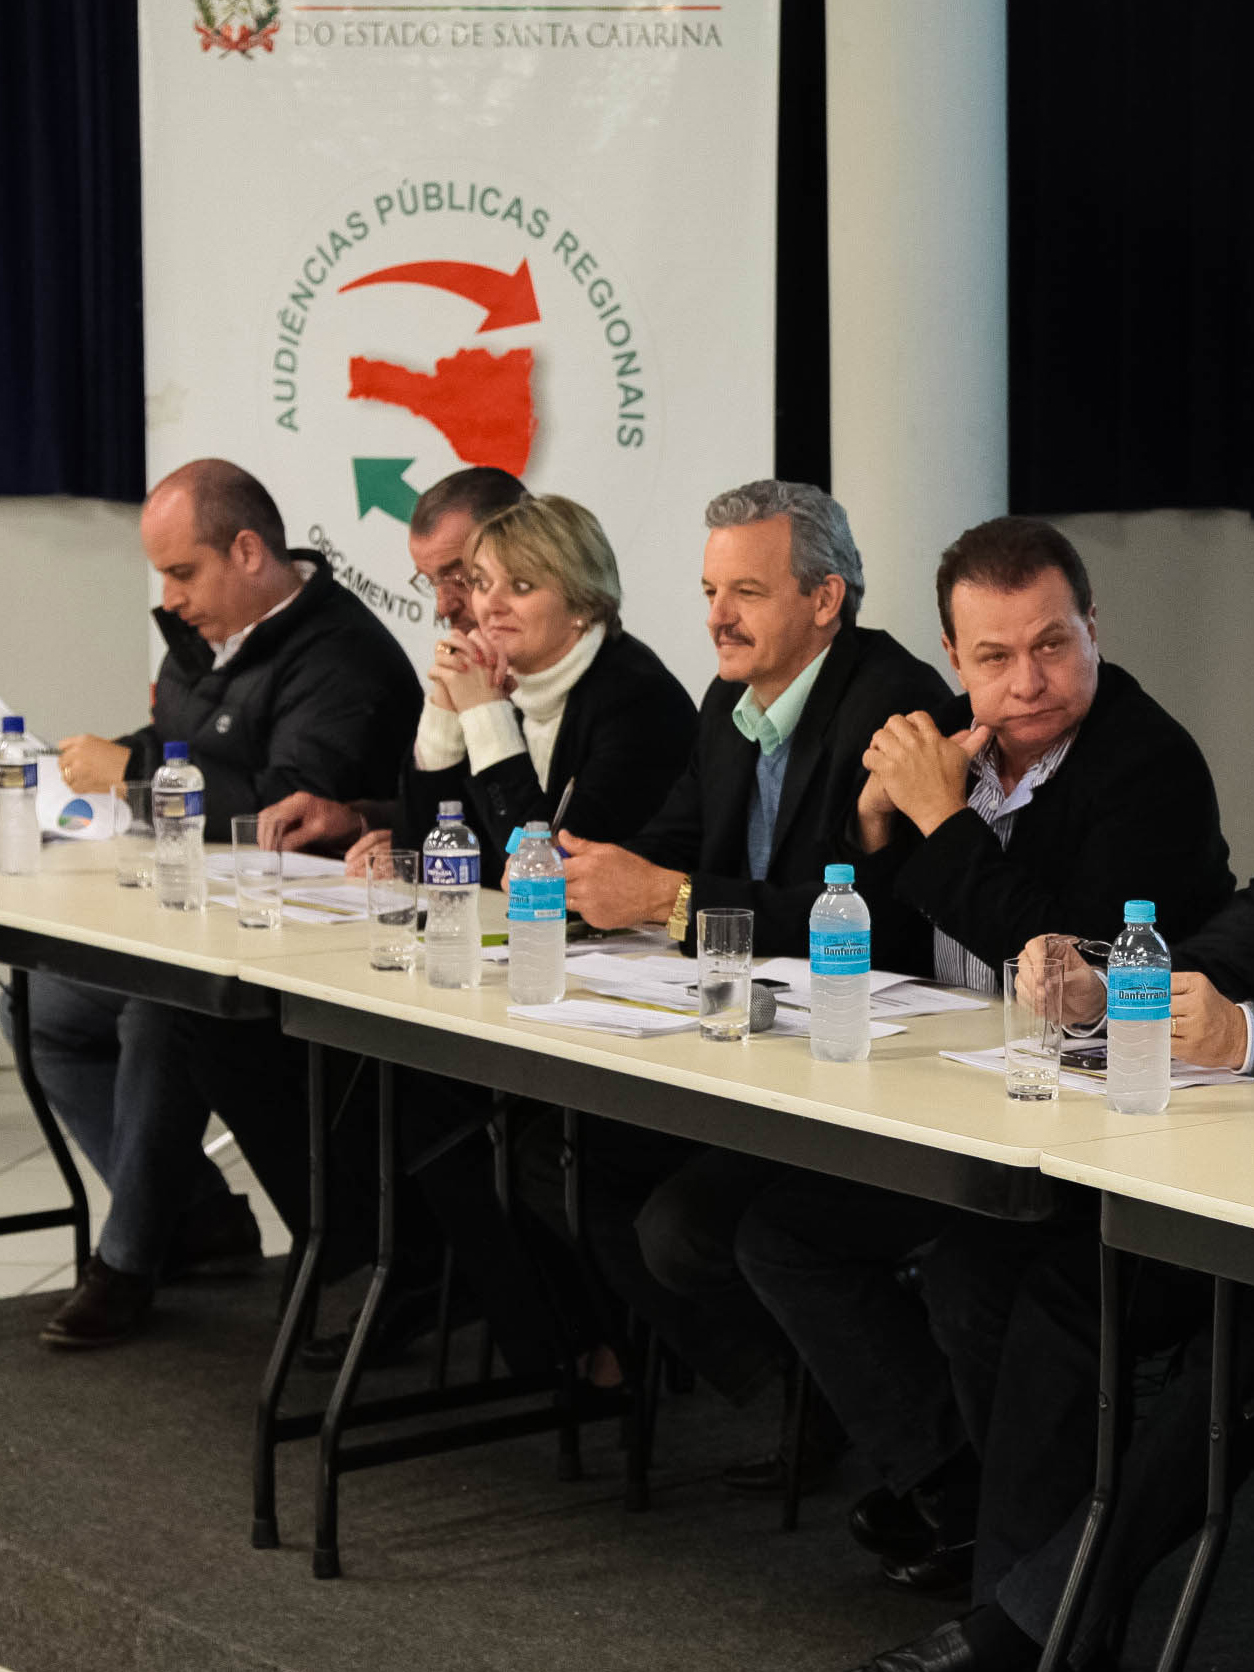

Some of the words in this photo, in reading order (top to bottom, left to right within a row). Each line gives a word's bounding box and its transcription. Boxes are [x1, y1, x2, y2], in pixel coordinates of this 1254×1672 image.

[294, 22, 335, 46] DO
[343, 22, 440, 47] ESTADO
[451, 22, 484, 47] DE
[493, 22, 578, 47] SANTA
[586, 22, 723, 48] CATARINA
[273, 210, 370, 432] AUDIÊNCIAS
[374, 178, 550, 239] PÚBLICAS
[552, 231, 645, 450] REGIONAIS
